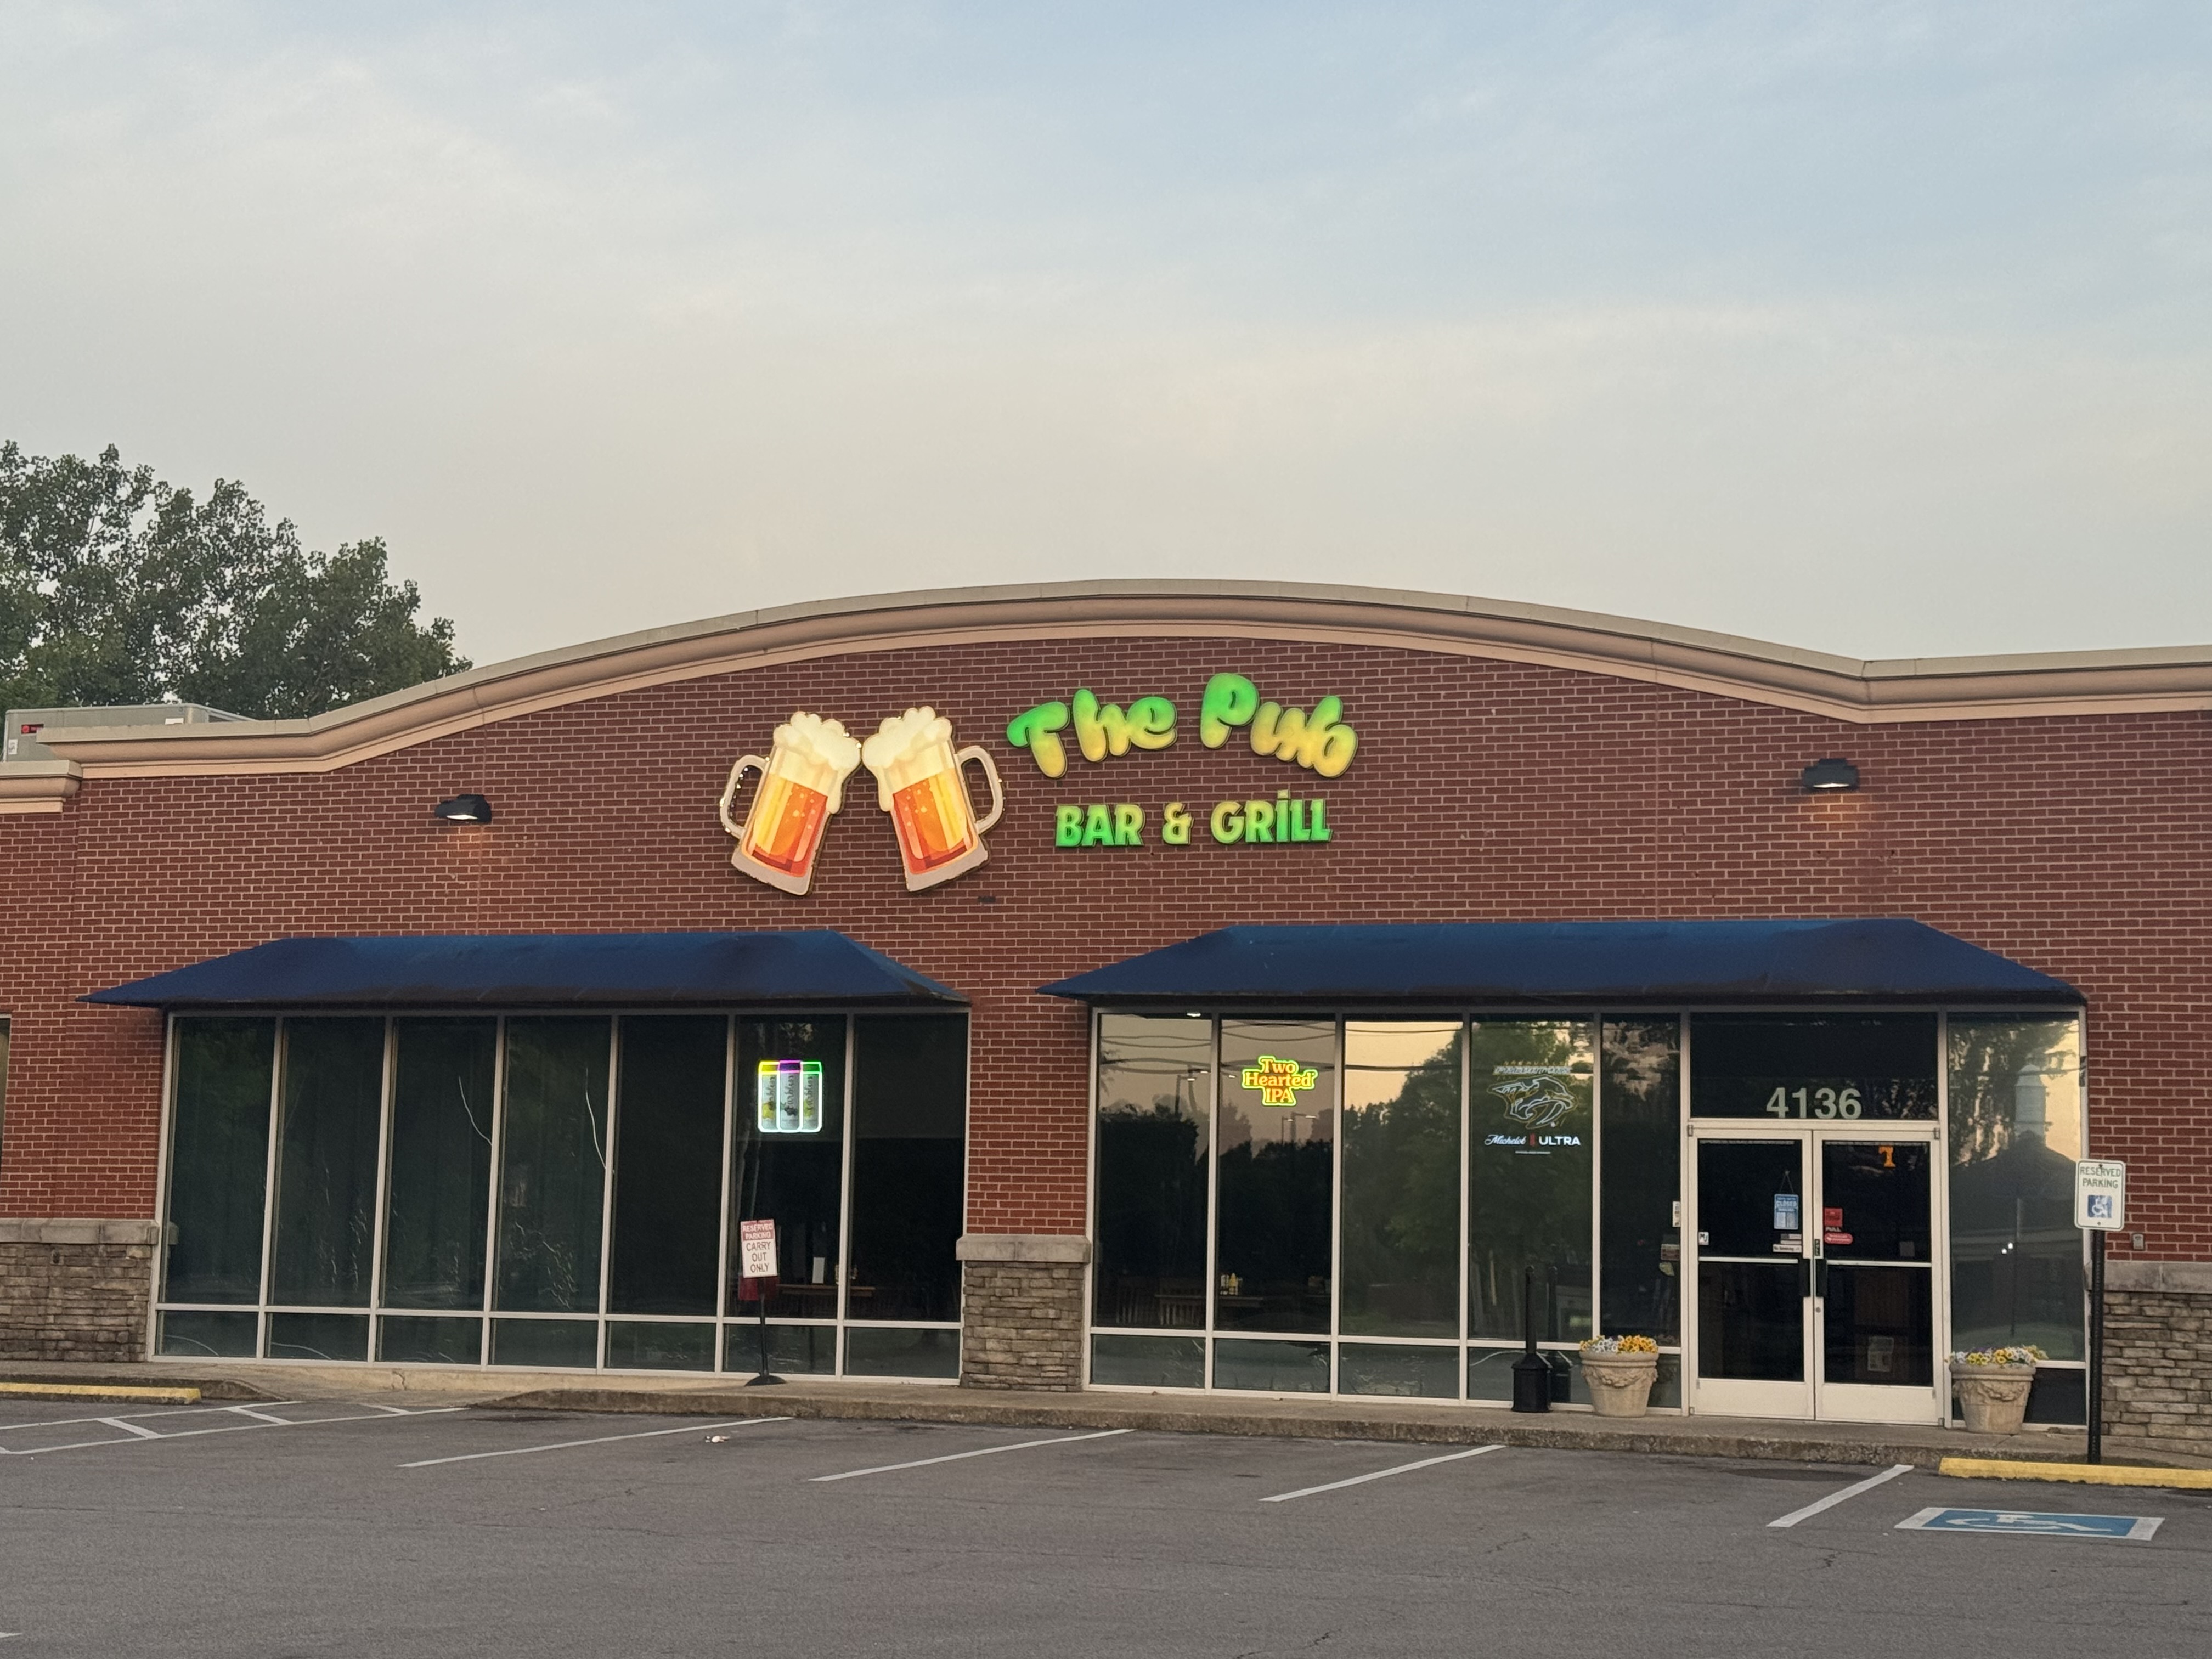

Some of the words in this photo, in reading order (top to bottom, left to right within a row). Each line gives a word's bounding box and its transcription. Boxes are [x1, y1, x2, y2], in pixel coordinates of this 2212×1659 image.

[1007, 688, 1177, 778] The
[1200, 672, 1358, 778] Pub
[1055, 804, 1146, 847] BAR
[1162, 802, 1193, 845] &
[1261, 1059, 1296, 1074] Two
[1245, 1071, 1312, 1087] Hearted
[1266, 1088, 1294, 1103] IPA
[1766, 1087, 1862, 1120] 4136
[1538, 1136, 1581, 1146] ULTRA
[2080, 1167, 2121, 1177] RESERVED
[2083, 1178, 2118, 1189] PARKING
[743, 1224, 773, 1232] RESERVED
[746, 1241, 771, 1251] CARRY
[752, 1252, 767, 1262] OUT
[750, 1263, 769, 1273] ONLY
